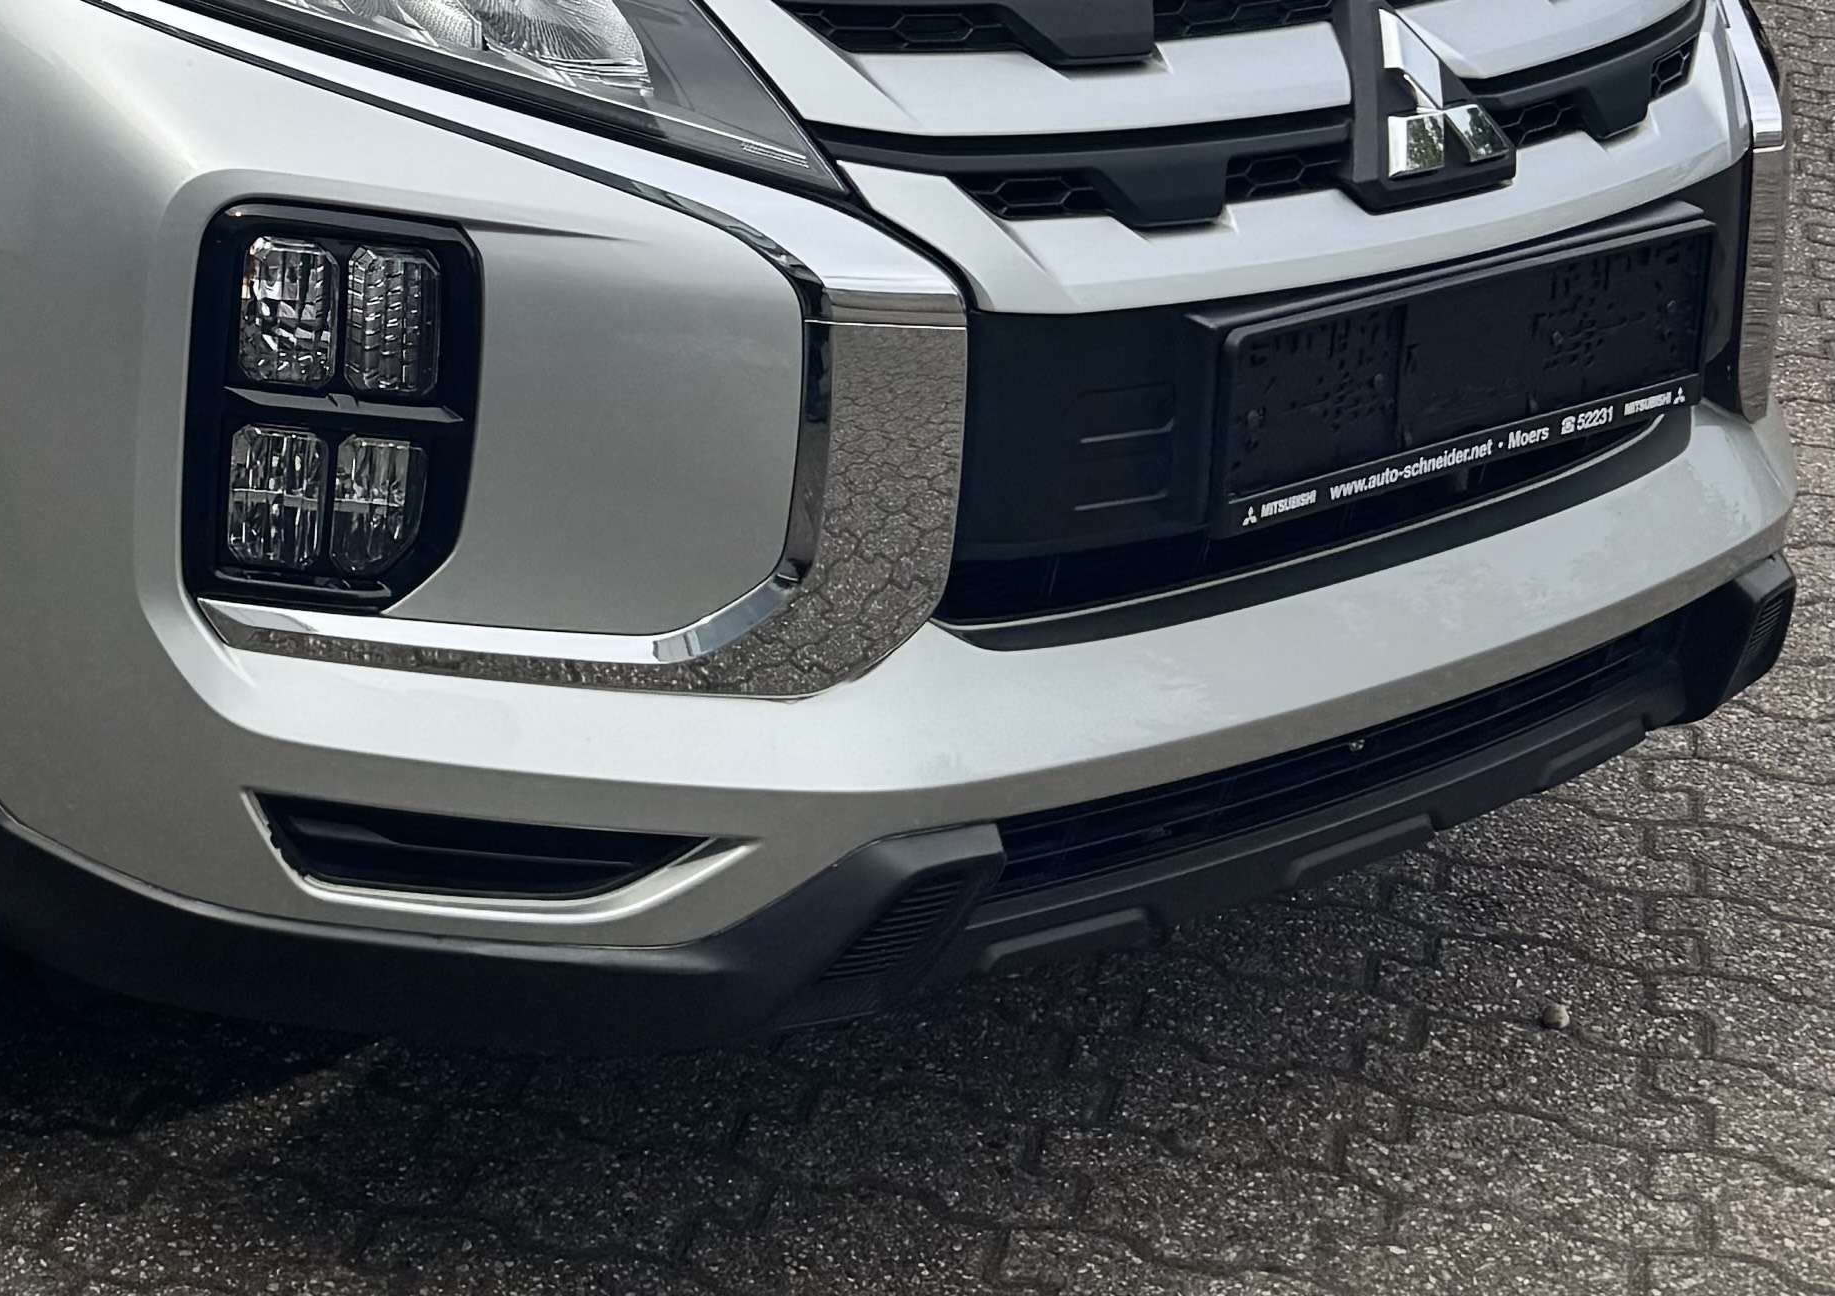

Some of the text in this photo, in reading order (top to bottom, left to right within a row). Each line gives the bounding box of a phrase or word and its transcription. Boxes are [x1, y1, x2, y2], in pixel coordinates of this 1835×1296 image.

[1260, 391, 1672, 518] MITSUBISHI www.auto-schneider.net Moers 52231 MITSUBISHI
